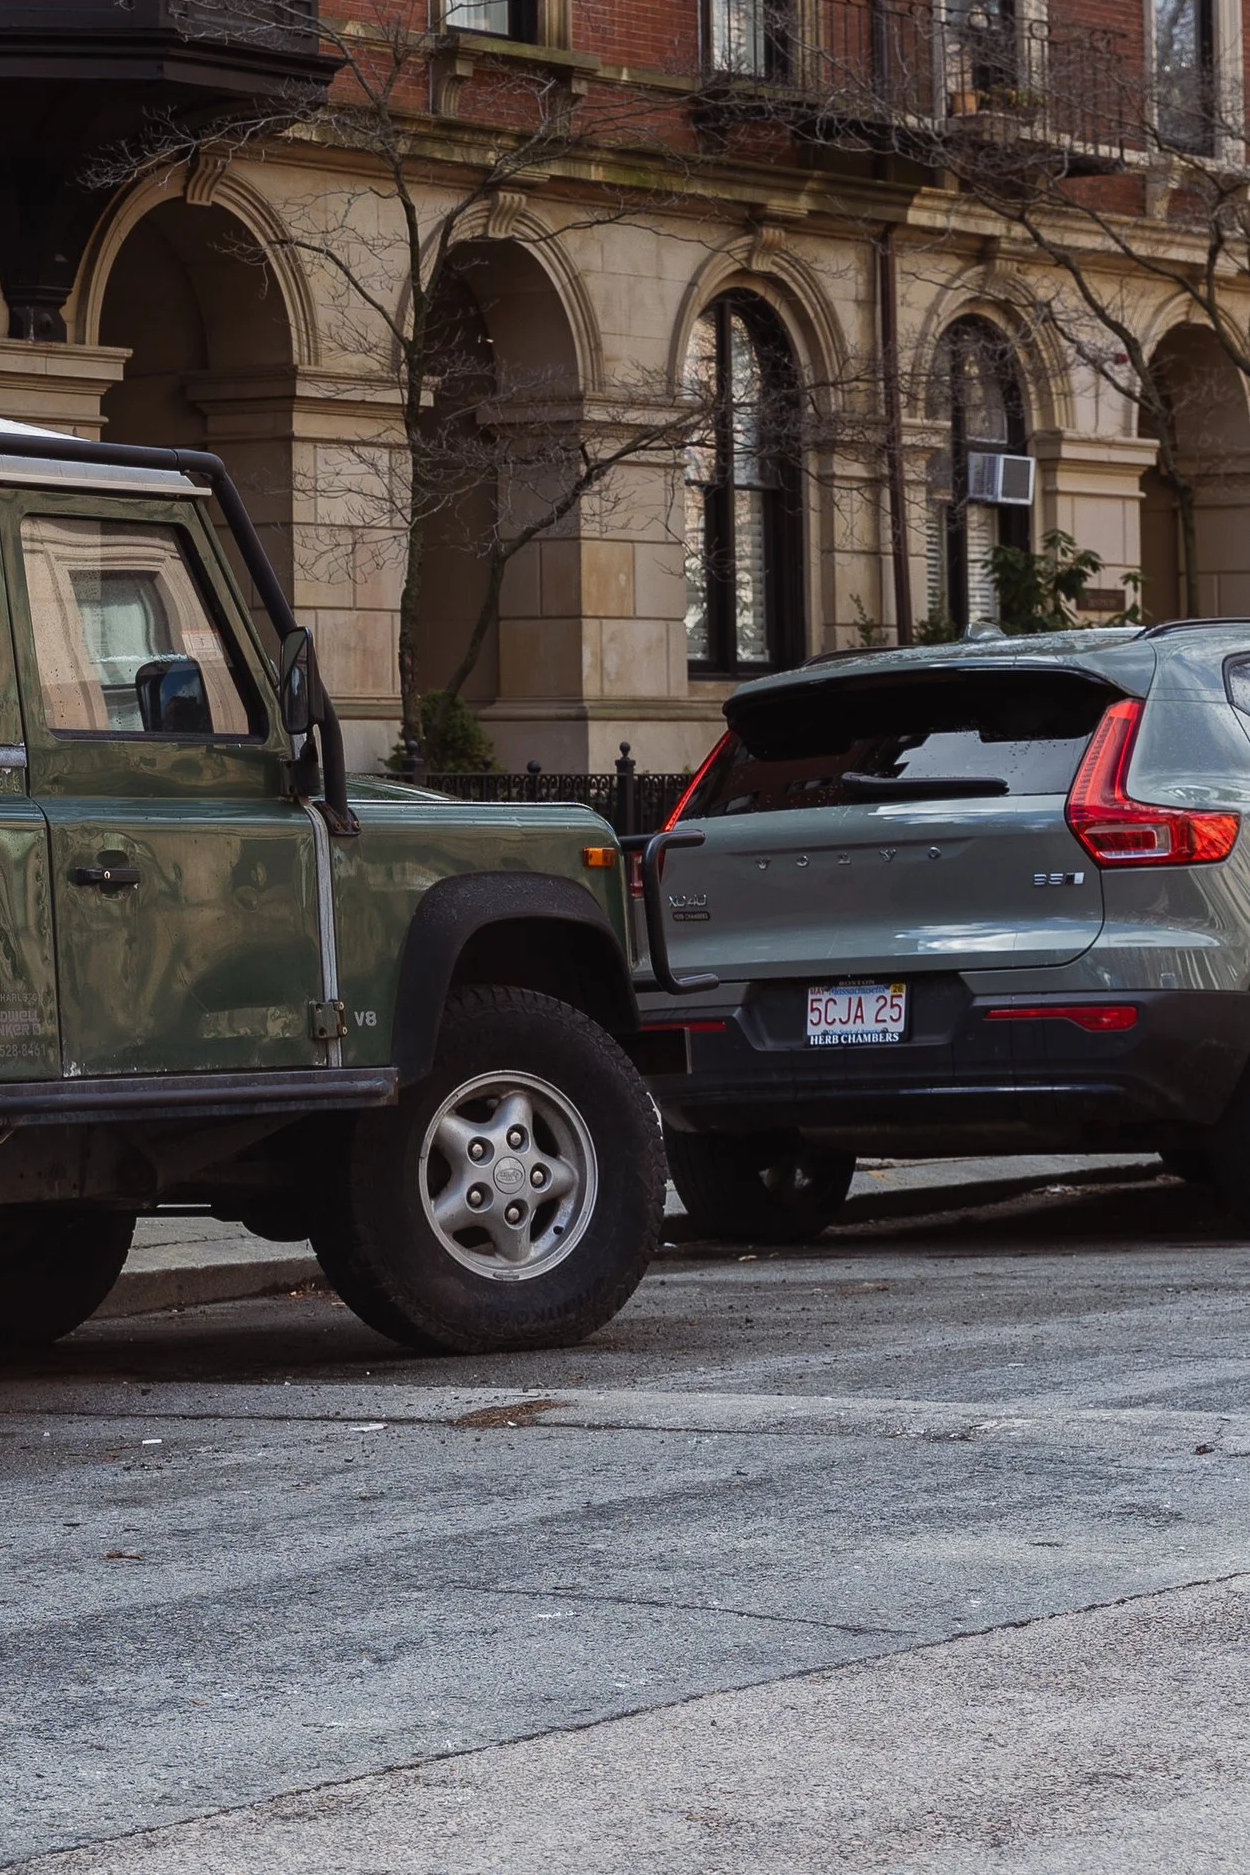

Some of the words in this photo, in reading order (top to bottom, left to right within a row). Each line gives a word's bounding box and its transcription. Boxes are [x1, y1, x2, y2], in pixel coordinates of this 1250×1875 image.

[755, 846, 942, 871] VOLVO
[354, 1010, 377, 1026] V8
[810, 996, 865, 1027] 5CJA
[875, 994, 903, 1023] 25
[810, 1034, 839, 1045] HERB
[840, 1032, 899, 1044] CHAMBERS
